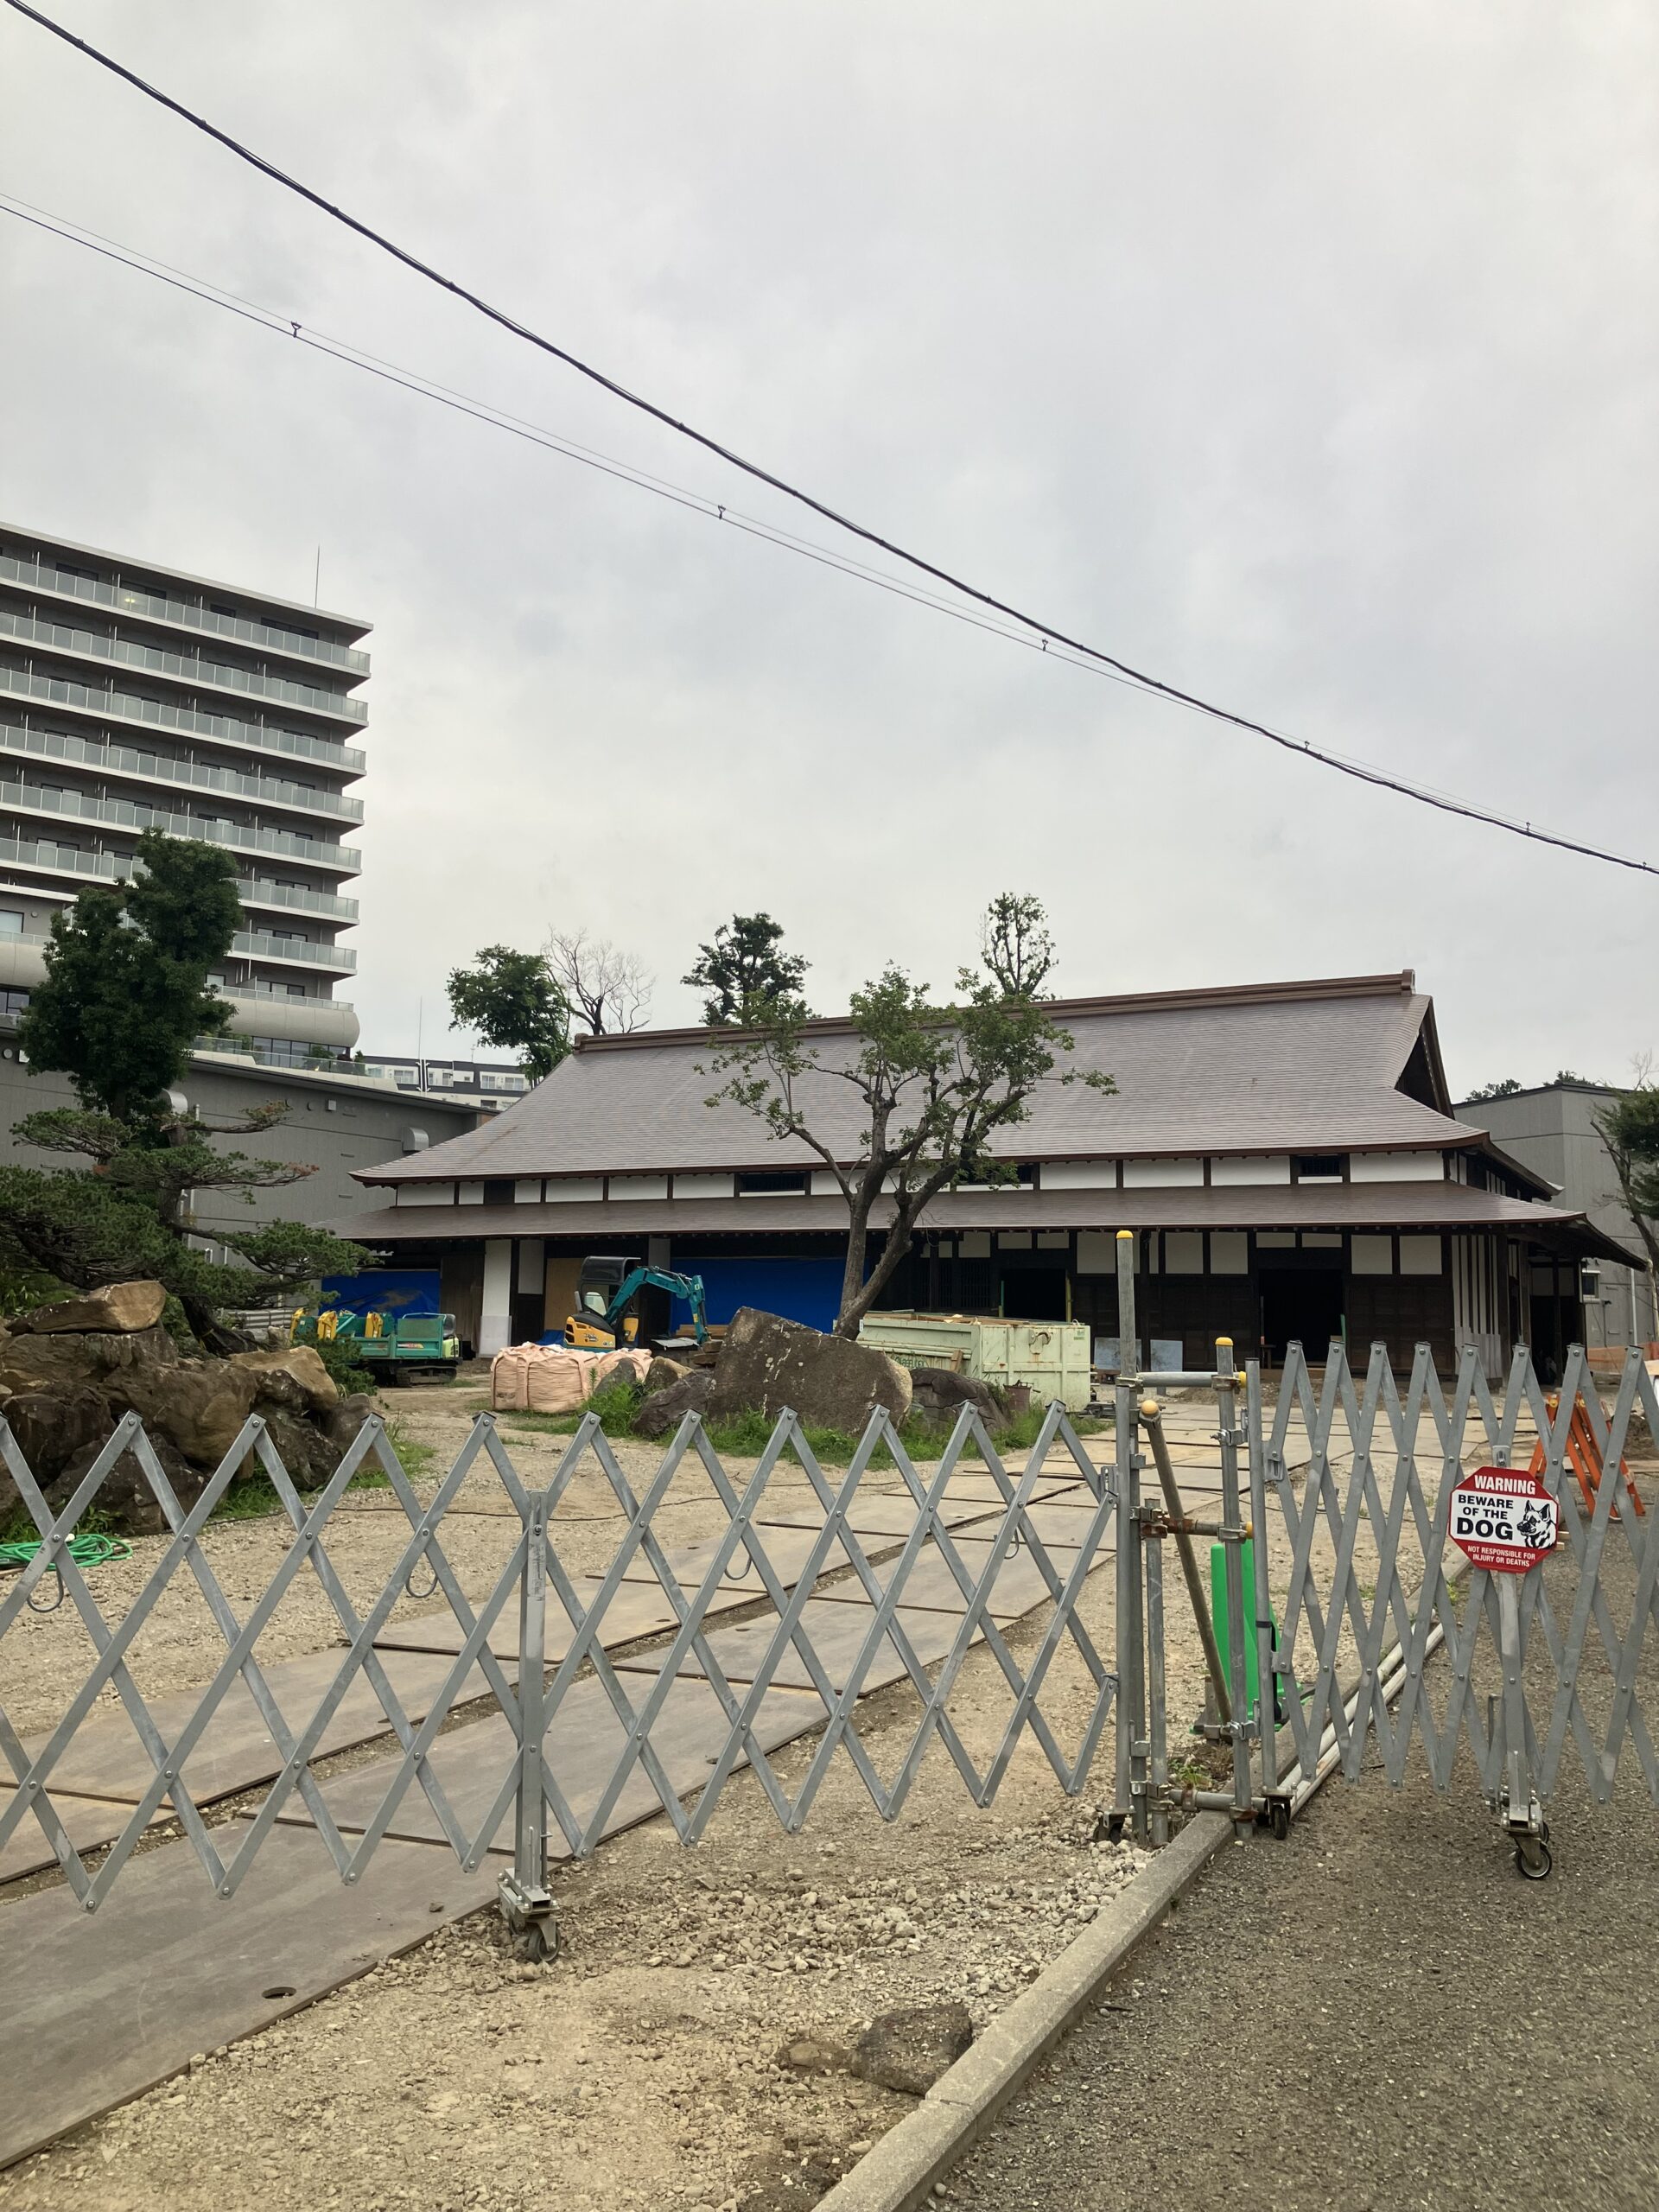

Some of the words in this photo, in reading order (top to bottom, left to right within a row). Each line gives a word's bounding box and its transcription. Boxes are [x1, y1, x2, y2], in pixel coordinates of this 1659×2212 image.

[1474, 1475, 1535, 1495] WARNING
[1458, 1494, 1514, 1509] BEWARE
[1463, 1507, 1479, 1516] OF
[1484, 1509, 1508, 1520] THE
[1457, 1517, 1513, 1541] DOG
[1482, 1547, 1522, 1558] RESPONSIBLE
[1506, 1558, 1529, 1567] DEATHS
